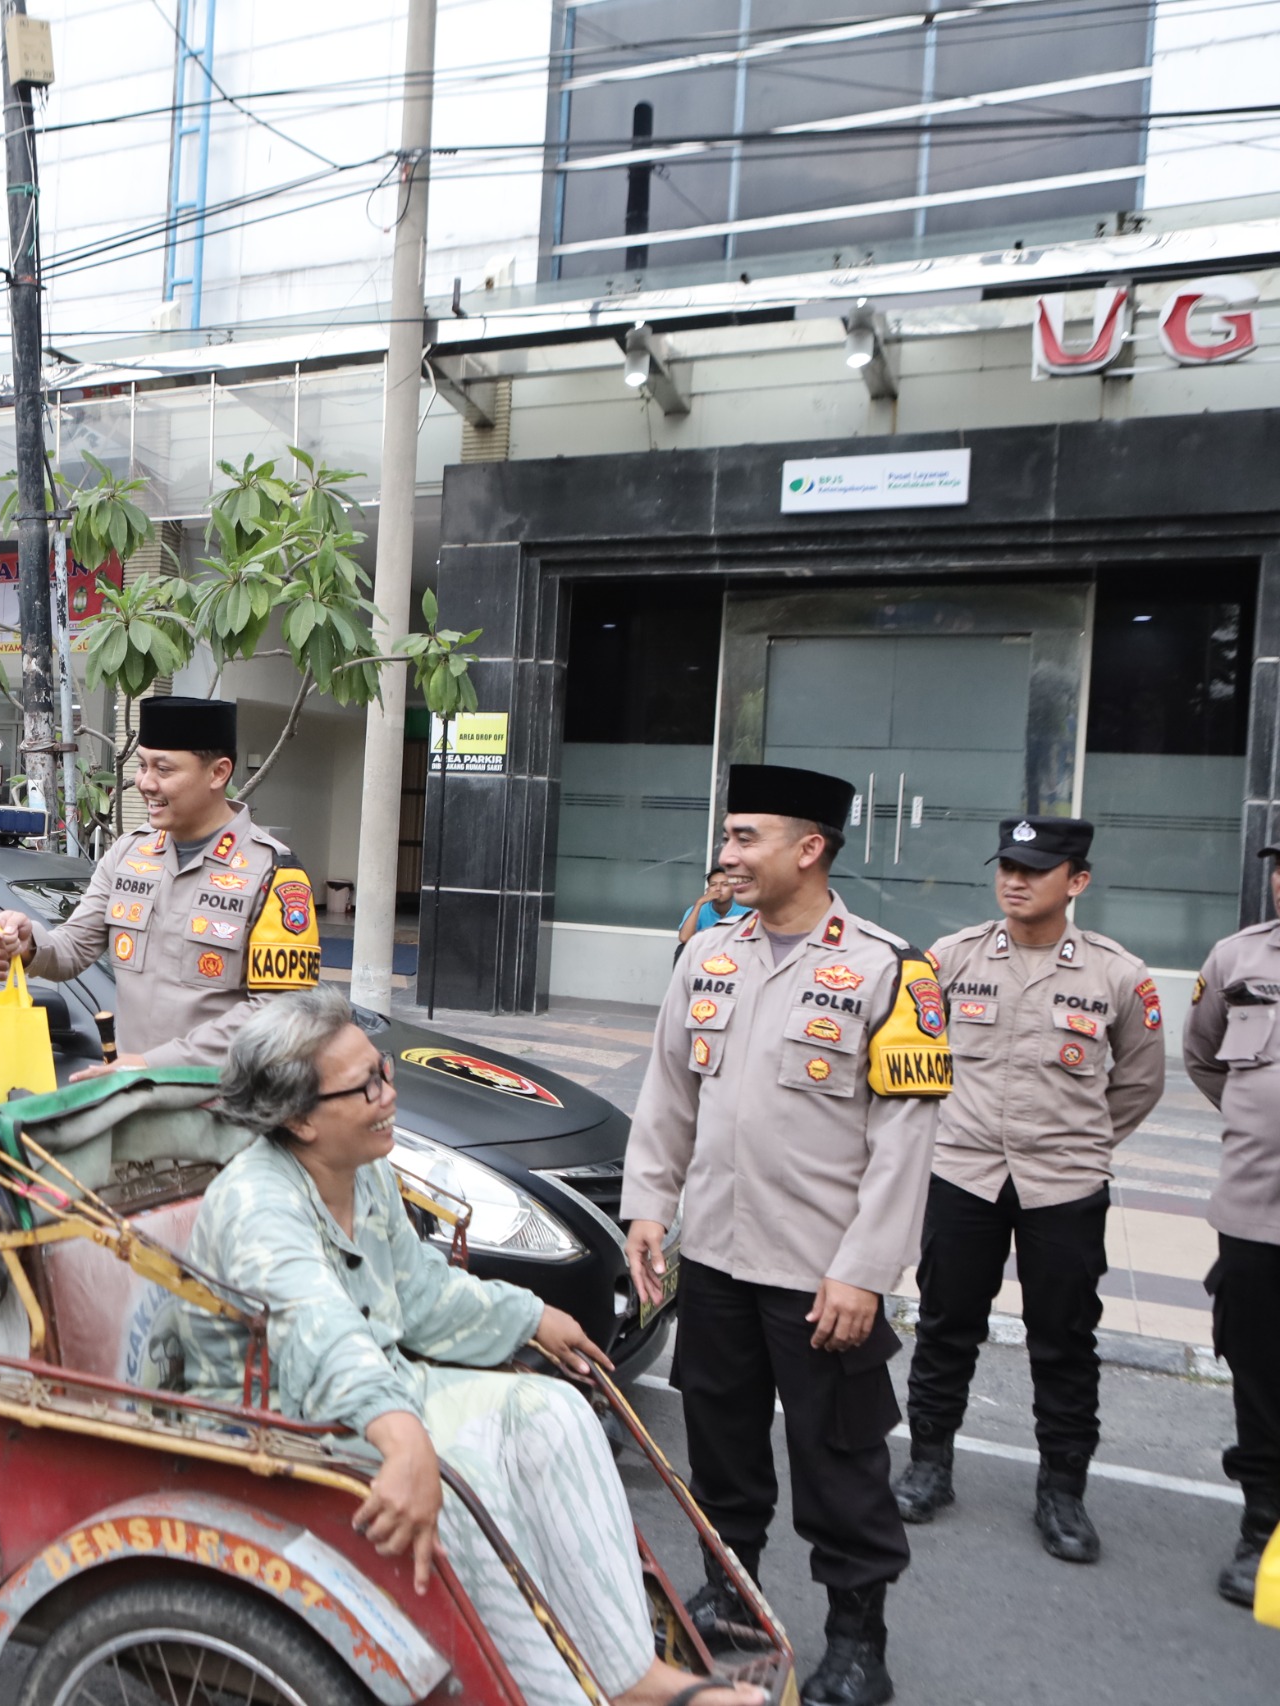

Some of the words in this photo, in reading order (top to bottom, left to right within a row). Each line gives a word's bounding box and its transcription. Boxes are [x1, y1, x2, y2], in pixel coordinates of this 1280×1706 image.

[475, 733, 492, 741] DROP
[463, 755, 503, 764] PARKIR
[465, 763, 486, 771] RUMAH
[115, 878, 154, 895] BOBBY
[198, 893, 243, 913] POLRI
[692, 978, 735, 994] MADE
[951, 981, 998, 997] FAHMI
[801, 991, 862, 1015] POLRI
[1053, 994, 1108, 1015] POLRI
